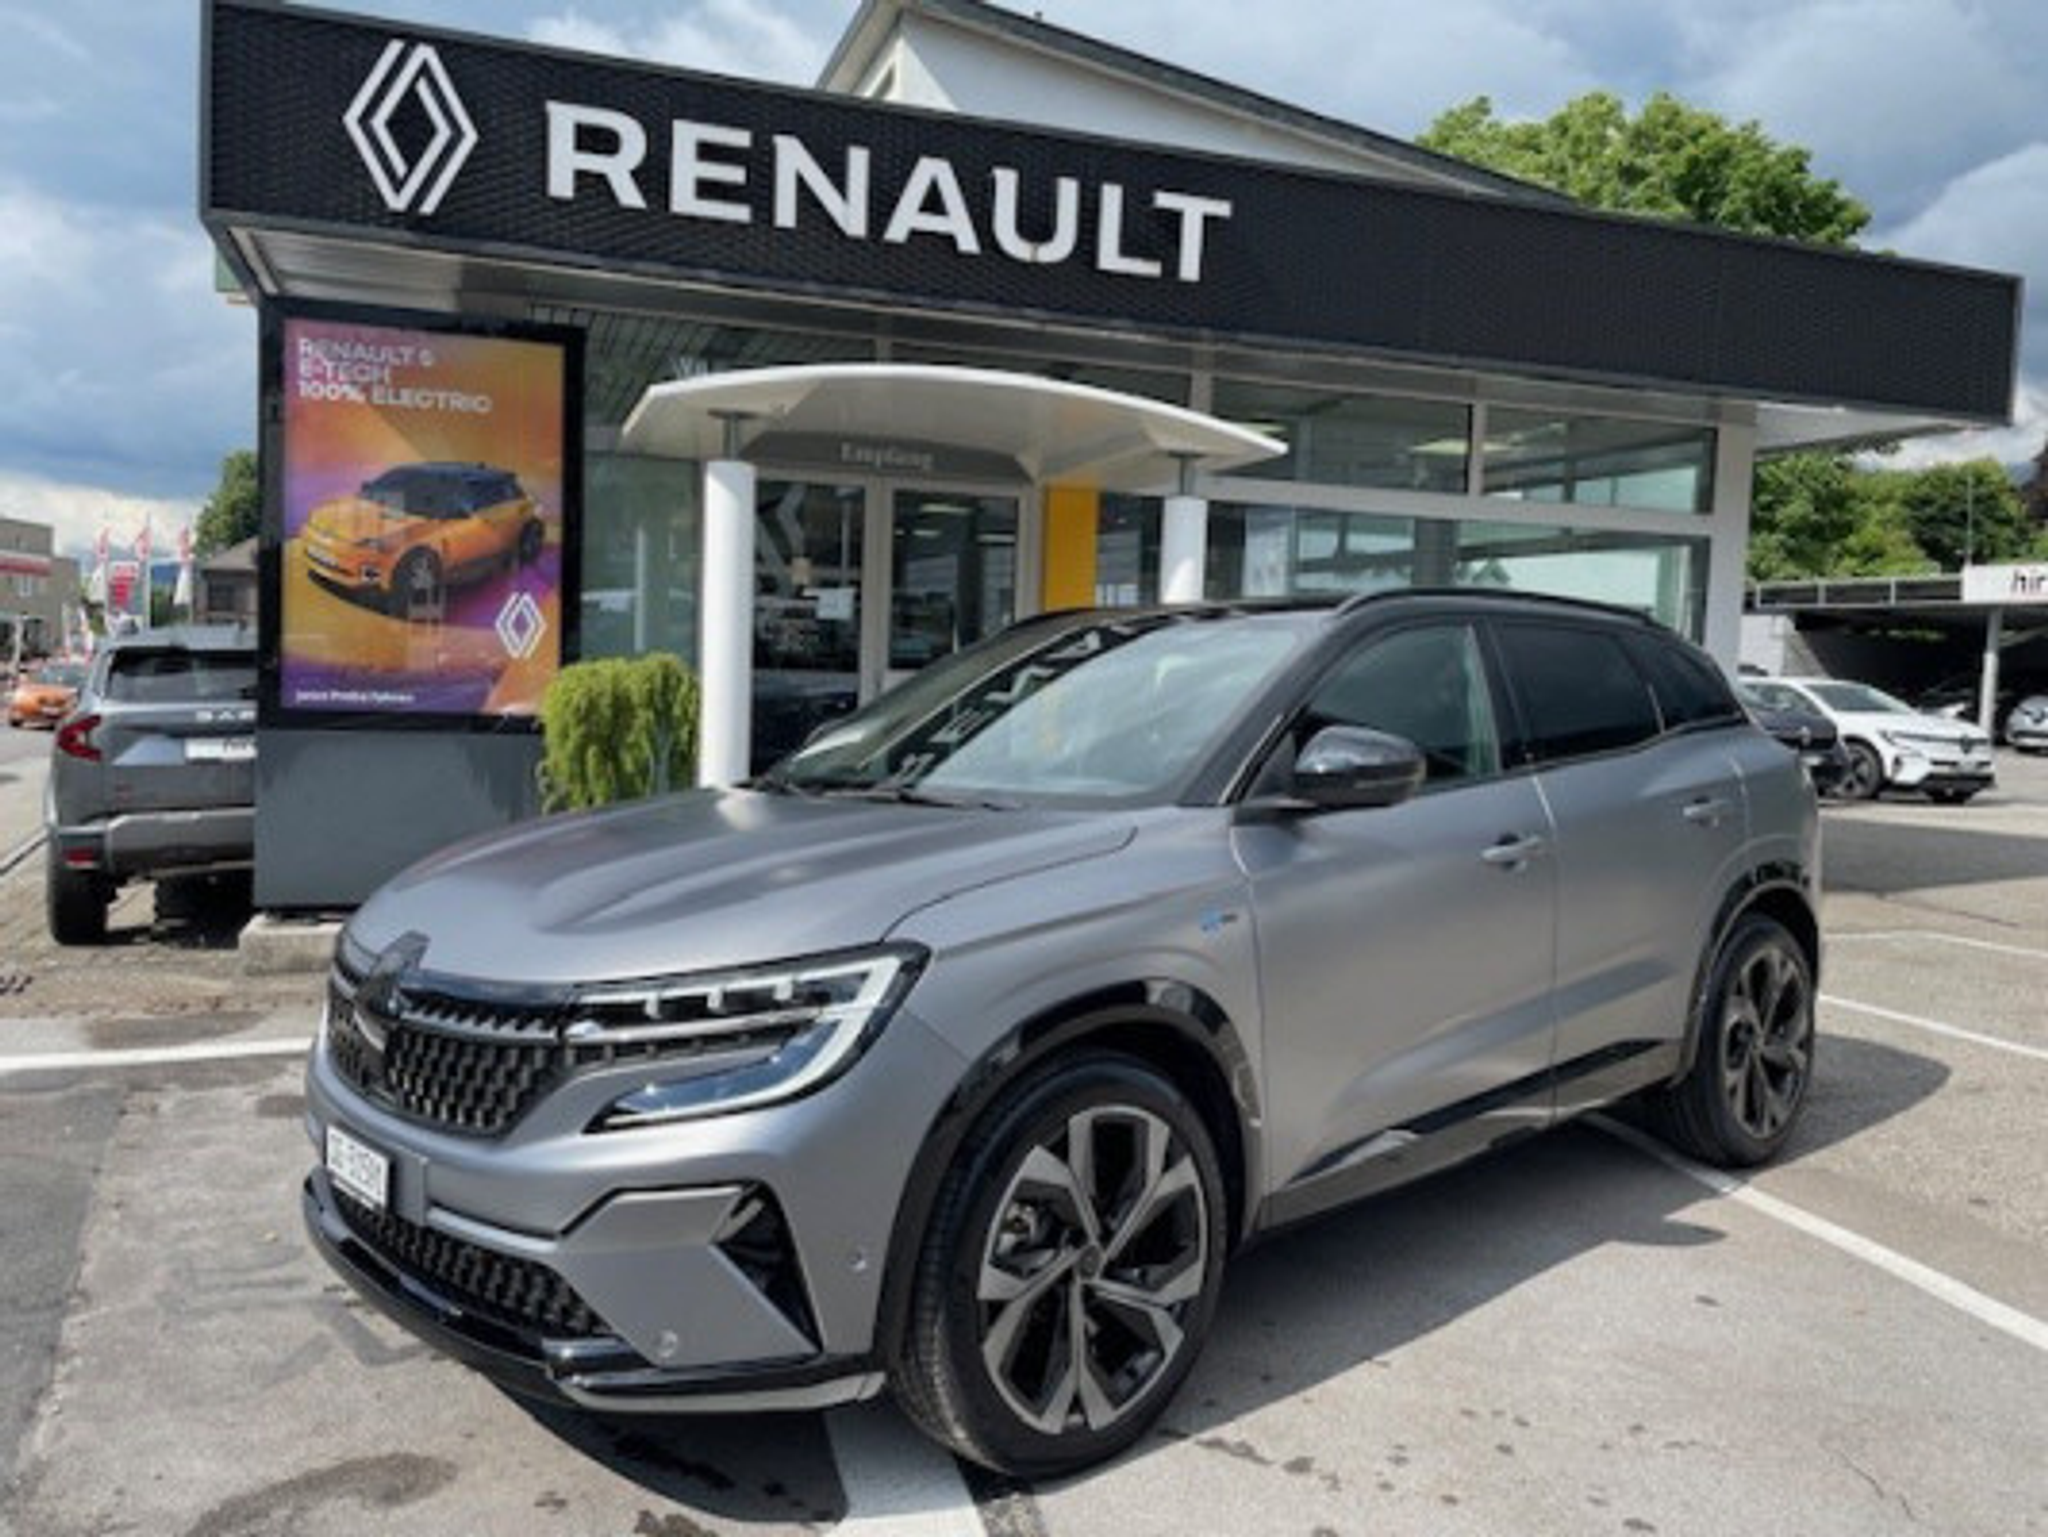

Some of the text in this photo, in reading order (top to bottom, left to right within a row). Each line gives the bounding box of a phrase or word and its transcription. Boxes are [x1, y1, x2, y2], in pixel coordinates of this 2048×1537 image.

[546, 100, 1231, 282] RENAULT
[299, 338, 416, 367] RENAULT
[299, 358, 390, 384] E-TECH
[299, 379, 492, 414] 100% ELECTRIC
